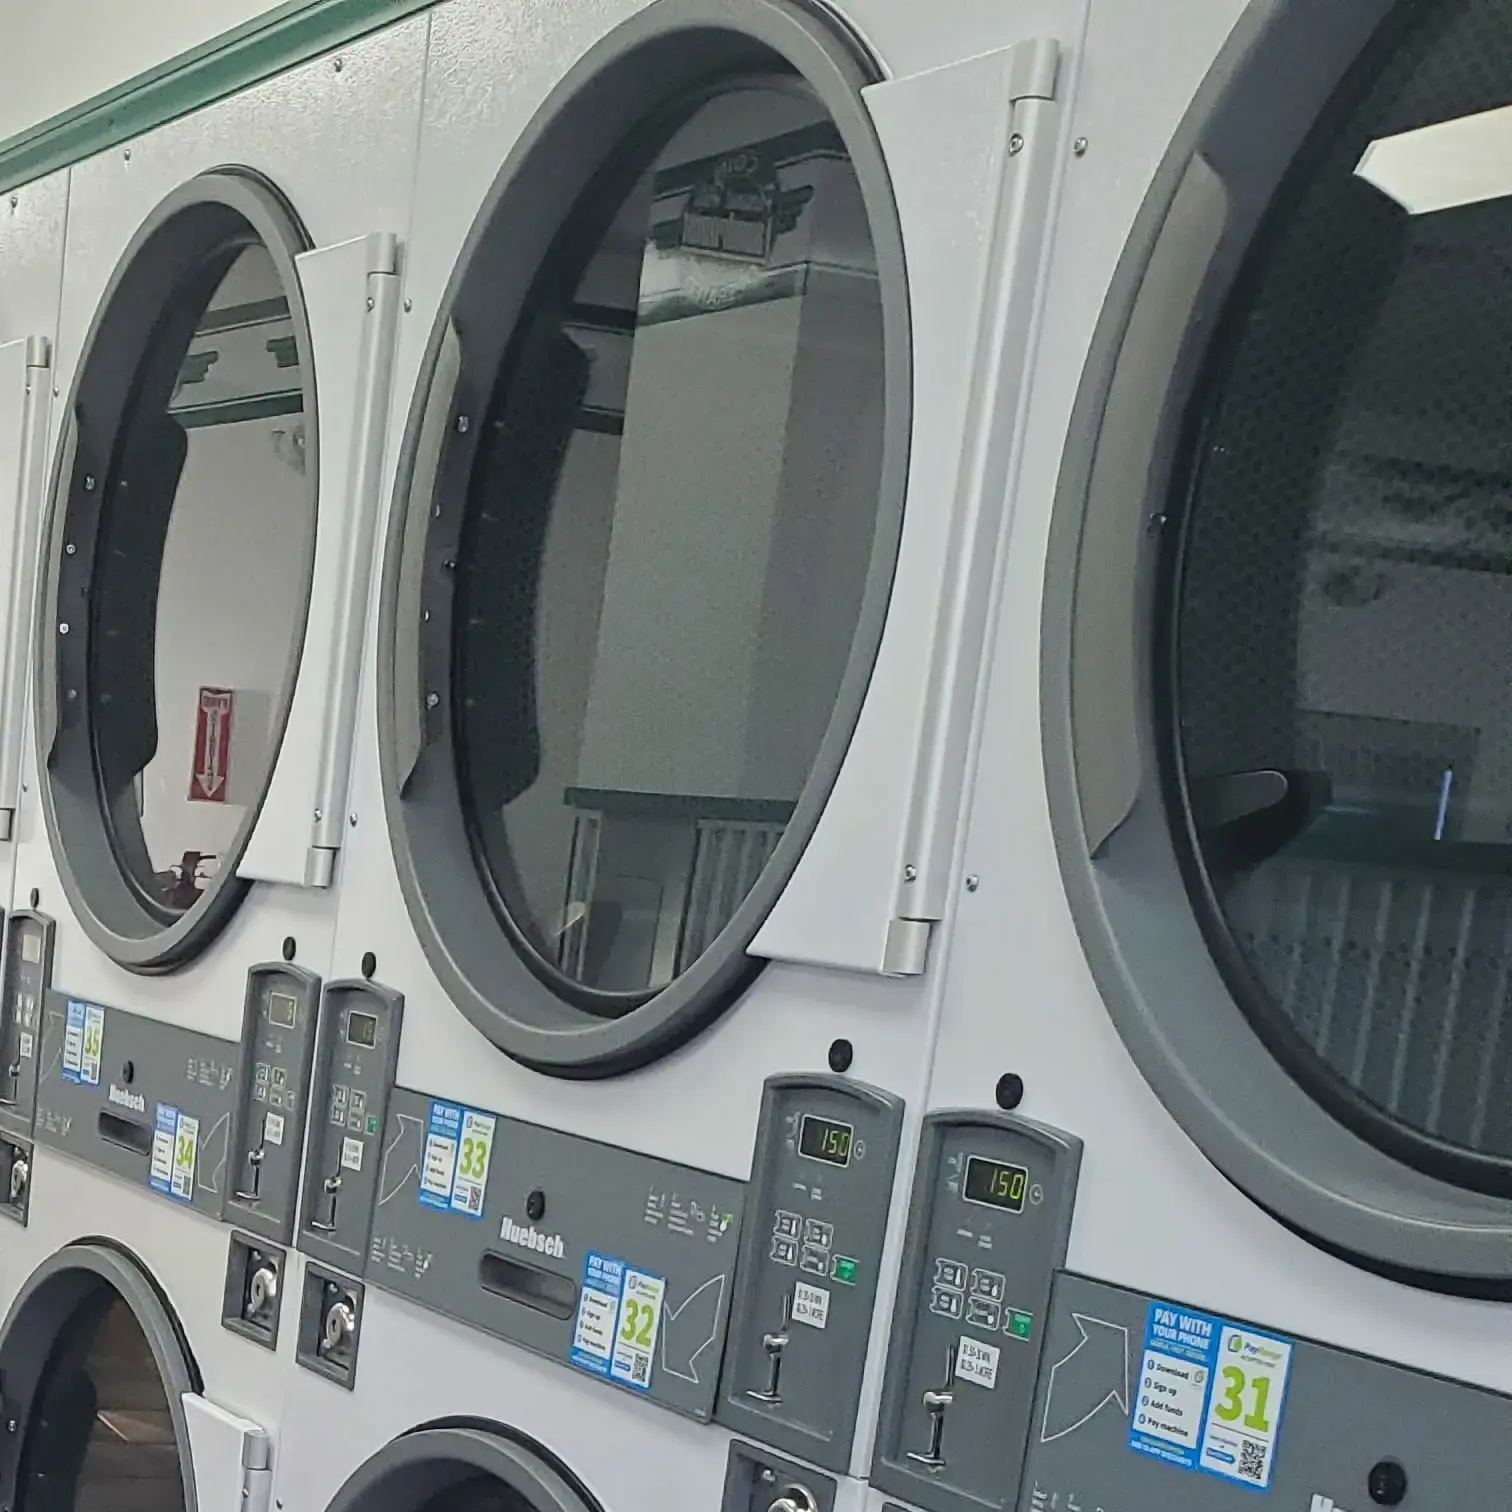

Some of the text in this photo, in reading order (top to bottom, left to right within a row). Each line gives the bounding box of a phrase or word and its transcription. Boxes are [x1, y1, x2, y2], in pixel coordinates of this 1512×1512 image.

[176, 1135, 193, 1169] 34
[459, 1137, 487, 1178] 33
[499, 1215, 564, 1259] Huebsch
[620, 1298, 654, 1347] 32
[1152, 1324, 1209, 1349] YOUR PHONE
[1154, 1308, 1212, 1337] PAY WITH
[1156, 1363, 1189, 1380] Download
[1153, 1381, 1167, 1393] Sign
[1168, 1387, 1177, 1397] up
[1214, 1365, 1270, 1433] 31
[1151, 1400, 1163, 1410] Add
[1164, 1403, 1183, 1416] funds
[1148, 1417, 1160, 1429] Pay
[1160, 1422, 1188, 1437] machine
